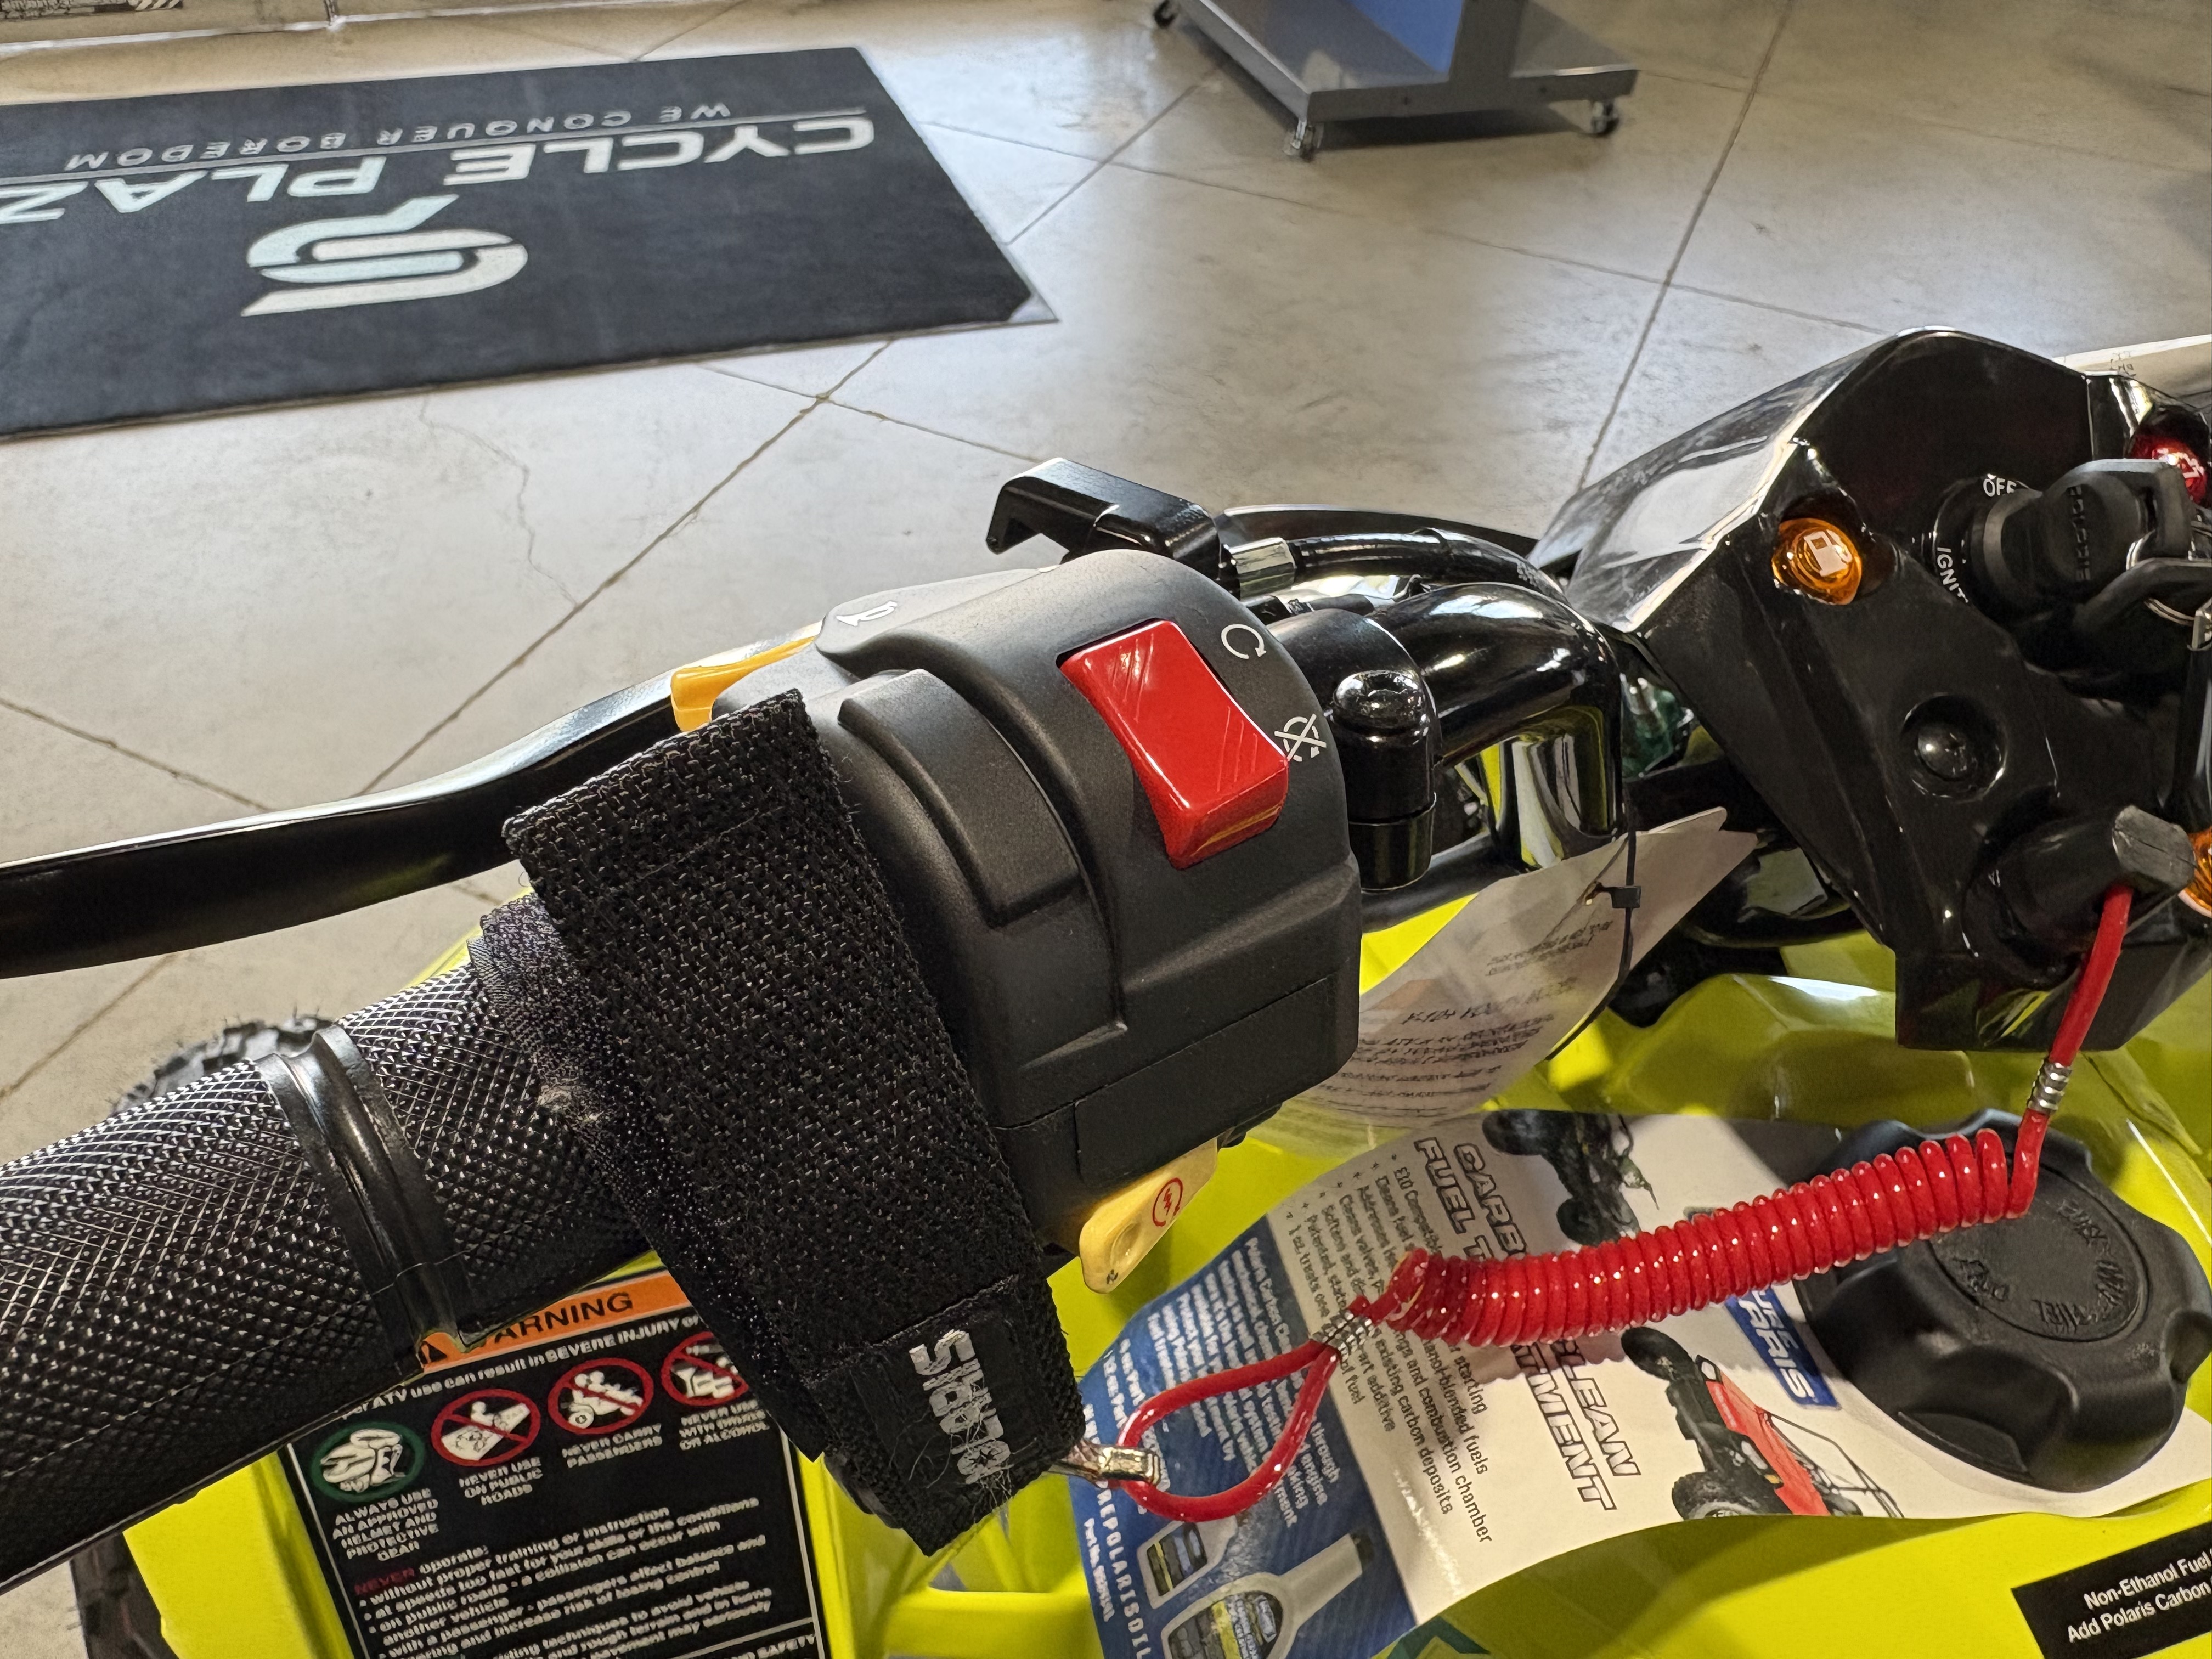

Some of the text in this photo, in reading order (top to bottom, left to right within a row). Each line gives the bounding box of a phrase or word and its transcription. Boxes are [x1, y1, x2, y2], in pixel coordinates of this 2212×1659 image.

[64, 103, 731, 171] WE CONQUER BOREDOM
[443, 117, 874, 185] CYCLE
[1983, 477, 2017, 497] OFF
[1937, 547, 1969, 603] IGNIT
[1413, 1136, 1476, 1235] FUEL
[1453, 1142, 1528, 1257] CARB
[489, 1291, 634, 1341] ARNING
[1751, 1285, 1799, 1353] URE
[370, 1389, 407, 1409] ATV
[410, 1381, 442, 1398] use
[444, 1373, 475, 1389] can
[477, 1358, 527, 1380] result
[528, 1355, 545, 1367] in
[545, 1334, 616, 1362] SEVERE
[617, 1318, 679, 1344] INJURY
[1736, 1291, 1816, 1405] ARIS
[1453, 1353, 1487, 1414] starting
[1375, 1339, 1404, 1396] existing
[1398, 1395, 1426, 1447] carbon
[1418, 1445, 1453, 1514] deposits
[1407, 1359, 1426, 1386] and
[1420, 1385, 1461, 1472] combustion
[1456, 1475, 1492, 1542] chamber
[1464, 1434, 1488, 1475] fuels
[459, 1466, 509, 1487] NEVER
[464, 1468, 543, 1498] ON PUBLIC
[332, 1499, 438, 1540] AN APPROVED
[335, 1497, 399, 1526] ALWAYS
[341, 1511, 437, 1548] HELMET AND
[370, 1576, 433, 1605] without
[436, 1559, 493, 1587] proper
[2083, 1551, 2211, 1610] Non-Ethanol Fuel
[2068, 1581, 2211, 1643] Add Polaris Carbon
